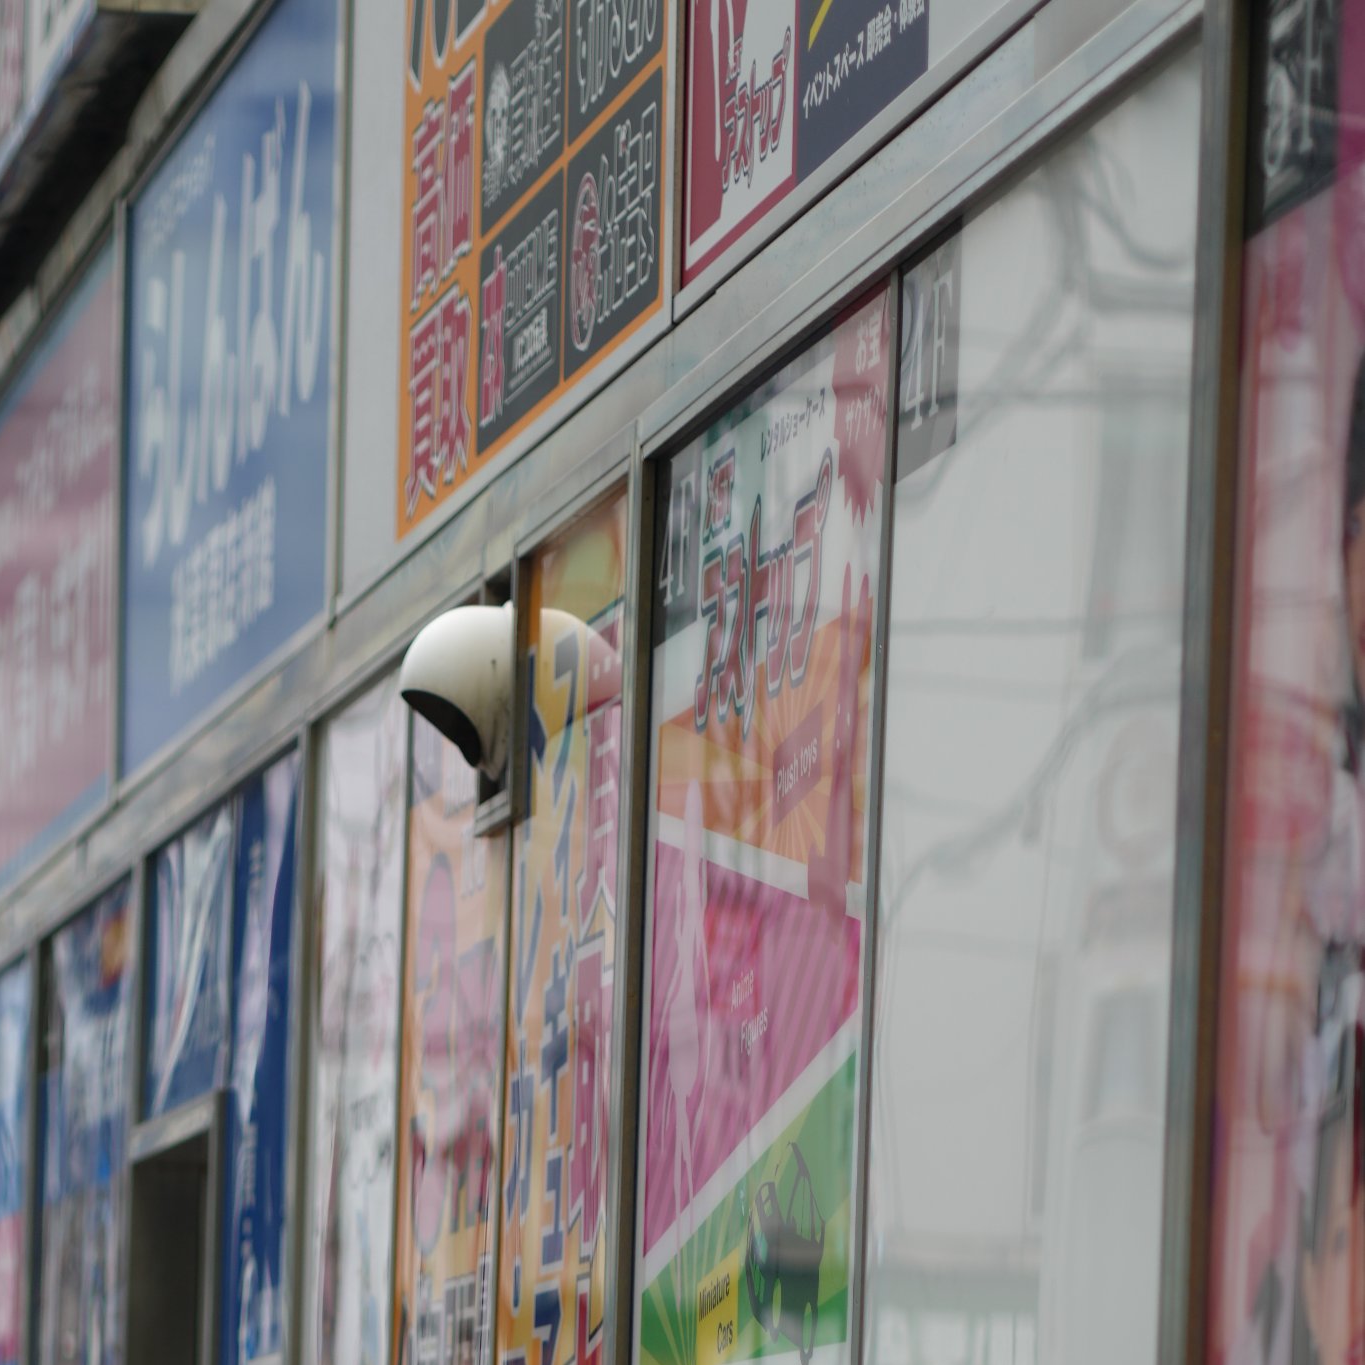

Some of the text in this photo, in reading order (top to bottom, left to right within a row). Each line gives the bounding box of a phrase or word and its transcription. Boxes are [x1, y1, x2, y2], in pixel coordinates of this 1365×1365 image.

[802, 30, 865, 119] イベントスペース
[904, 268, 953, 430] 4F
[403, 280, 474, 522] 買取
[760, 386, 826, 463] レンタルショーケース
[658, 472, 695, 607] 4F
[776, 740, 819, 802] Plush toys
[731, 968, 755, 1012] Anime
[740, 1006, 769, 1056] Figures
[698, 1272, 730, 1323] Miniature
[717, 1320, 734, 1354] Cars
